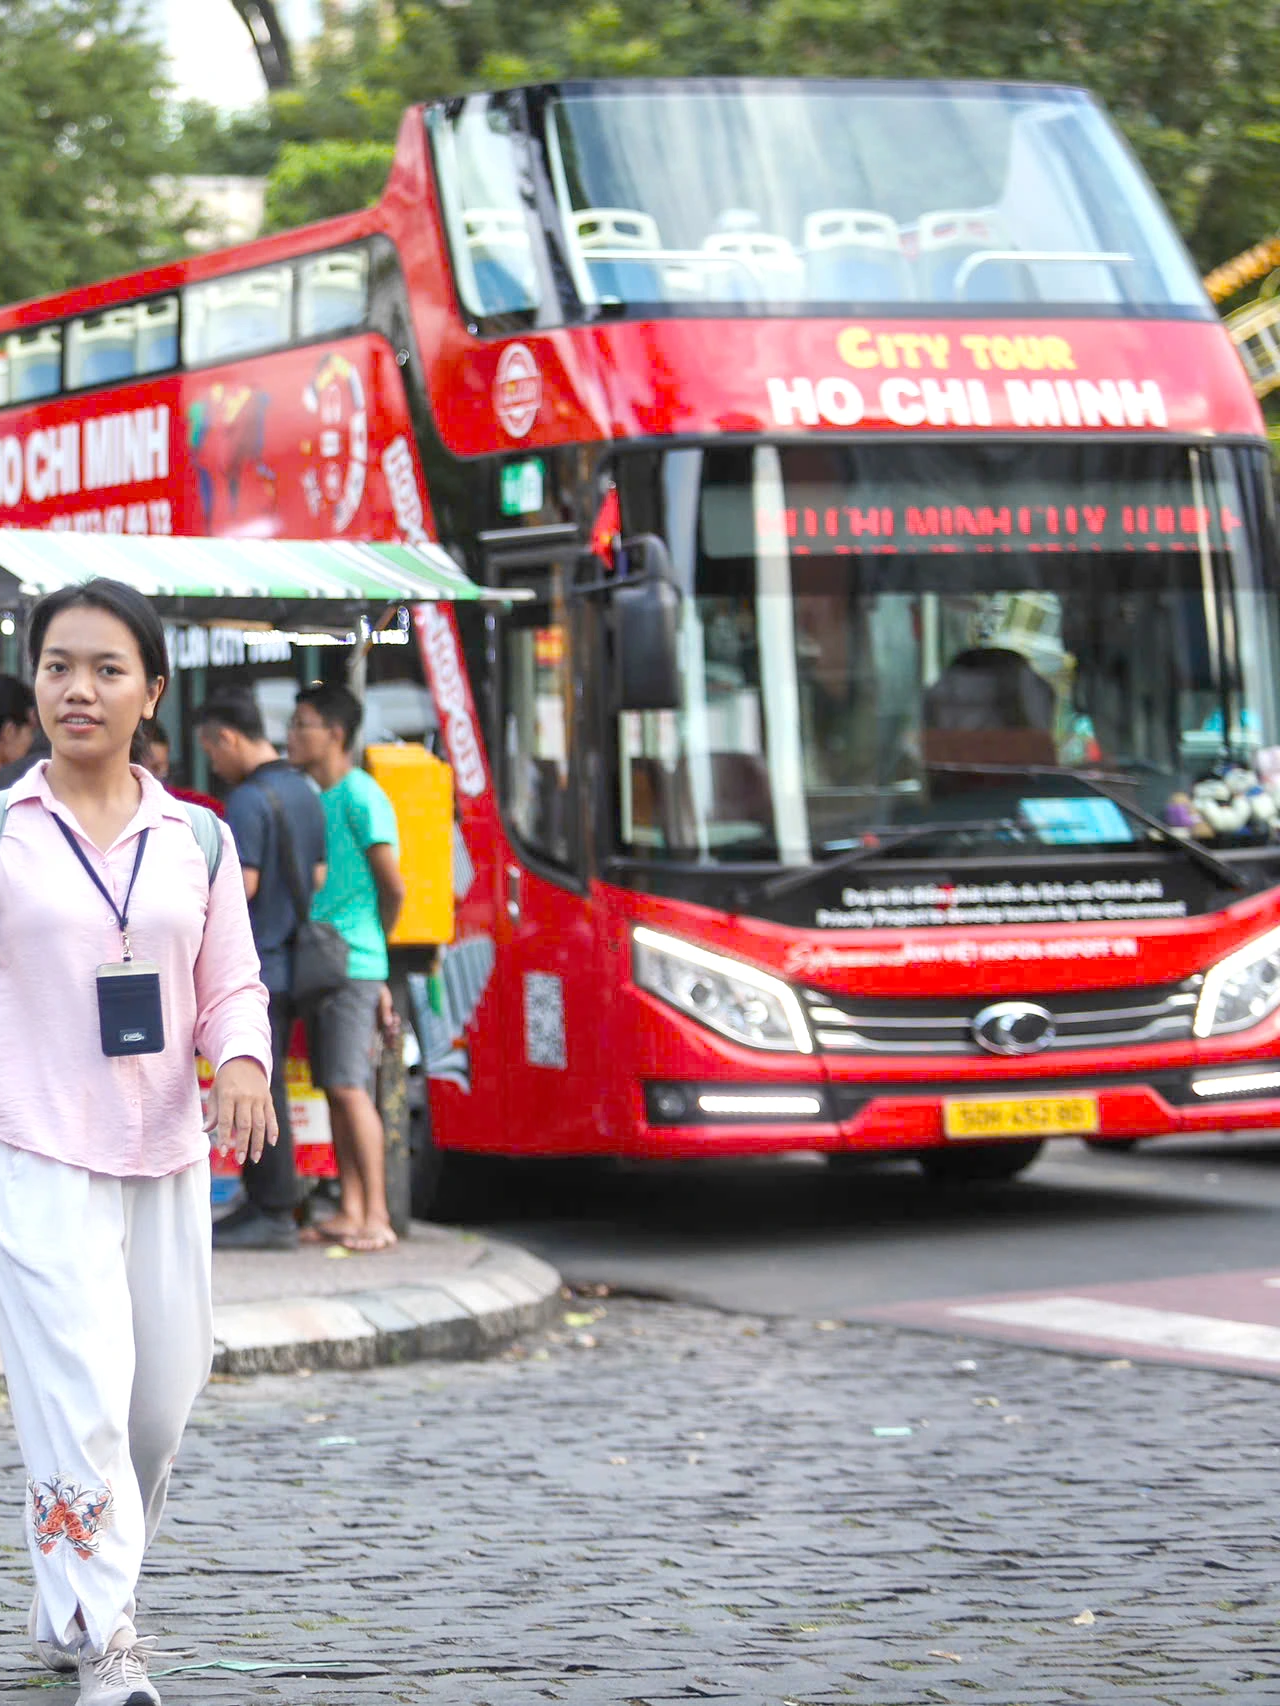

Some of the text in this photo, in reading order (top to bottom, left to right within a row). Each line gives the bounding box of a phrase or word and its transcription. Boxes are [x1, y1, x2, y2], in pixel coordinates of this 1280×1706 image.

[837, 327, 1078, 371] CITY TOUR
[766, 377, 1168, 428] HO CHI MINH
[26, 422, 81, 502] CHI
[83, 404, 170, 490] MINH
